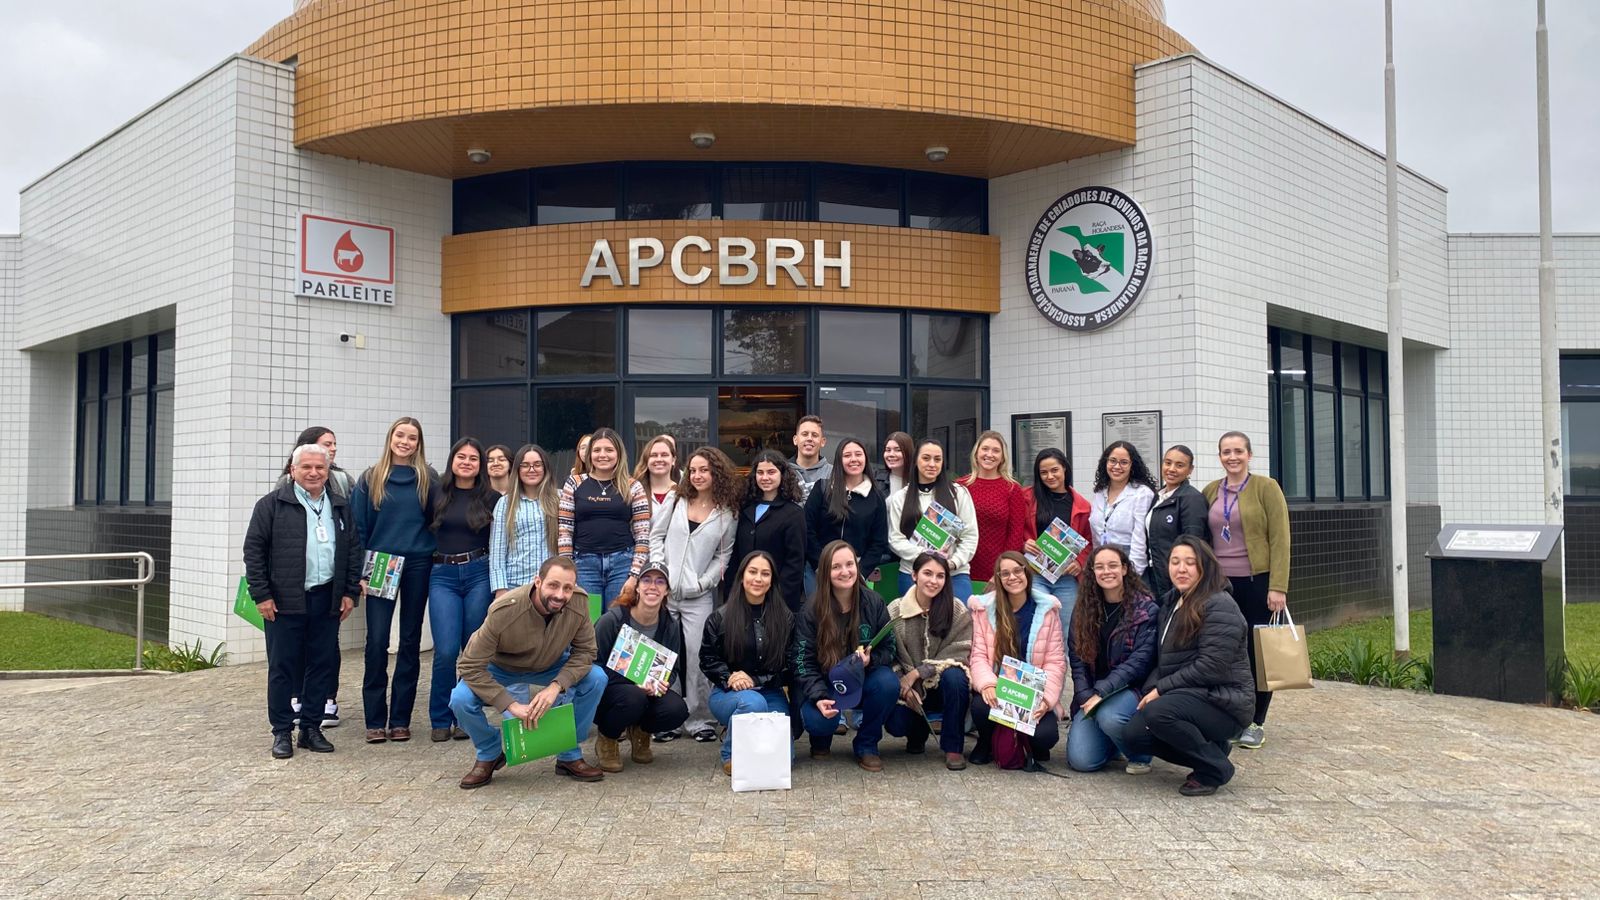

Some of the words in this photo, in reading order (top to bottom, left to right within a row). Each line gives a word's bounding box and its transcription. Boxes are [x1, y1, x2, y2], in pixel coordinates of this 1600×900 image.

[1047, 190, 1098, 220] CRIADORES
[1099, 190, 1112, 203] DE
[1040, 218, 1052, 233] DE
[1111, 194, 1144, 232] BOVINOS
[1091, 224, 1126, 235] HOLANDESA
[1136, 231, 1148, 247] DA
[579, 235, 851, 288] APCBRH
[1028, 232, 1044, 296] PARANAENSE
[1134, 247, 1149, 276] RAÇA
[302, 280, 393, 304] PARLEITE
[1051, 285, 1075, 294] PARANÁ
[1094, 279, 1142, 323] HOLANDESA
[1035, 293, 1086, 327] ASSOCIAÇÃO
